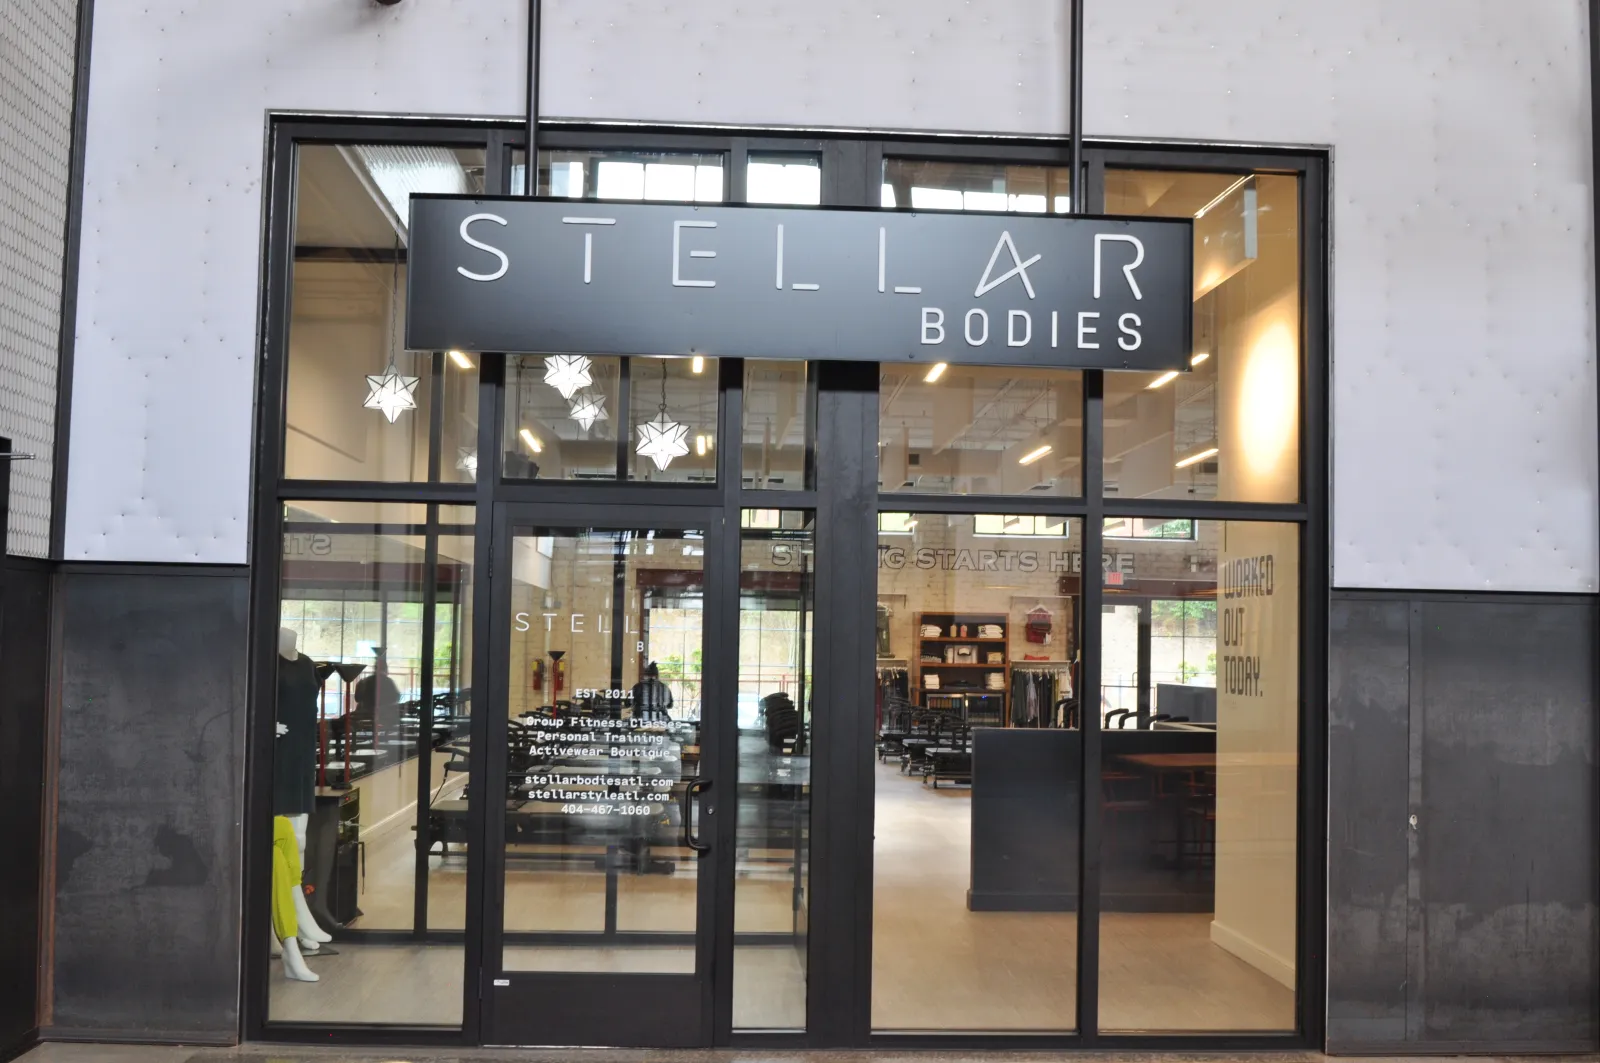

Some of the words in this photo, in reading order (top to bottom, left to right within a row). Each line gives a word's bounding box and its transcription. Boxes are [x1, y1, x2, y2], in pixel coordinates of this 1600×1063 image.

[456, 212, 1145, 301] STELLAR
[920, 306, 1143, 352] BODIES
[916, 546, 1040, 573] STARTS
[1223, 554, 1275, 600] WORKED
[514, 612, 640, 634] STELL
[1223, 607, 1246, 647] OUT
[1223, 655, 1264, 698] TODAY.
[575, 688, 599, 699] EST
[604, 688, 635, 700] 2011
[526, 716, 565, 729] Group
[570, 716, 623, 728] Fitness
[629, 717, 683, 730] Classes
[536, 731, 597, 743] Personal
[604, 732, 664, 745] Training
[528, 744, 604, 757] Activewear
[610, 747, 671, 760] Boutique
[524, 774, 675, 788] stellarbodiesatl.com
[527, 789, 671, 802] stellarstyleatl.com
[560, 804, 651, 816] 404-467-1060
